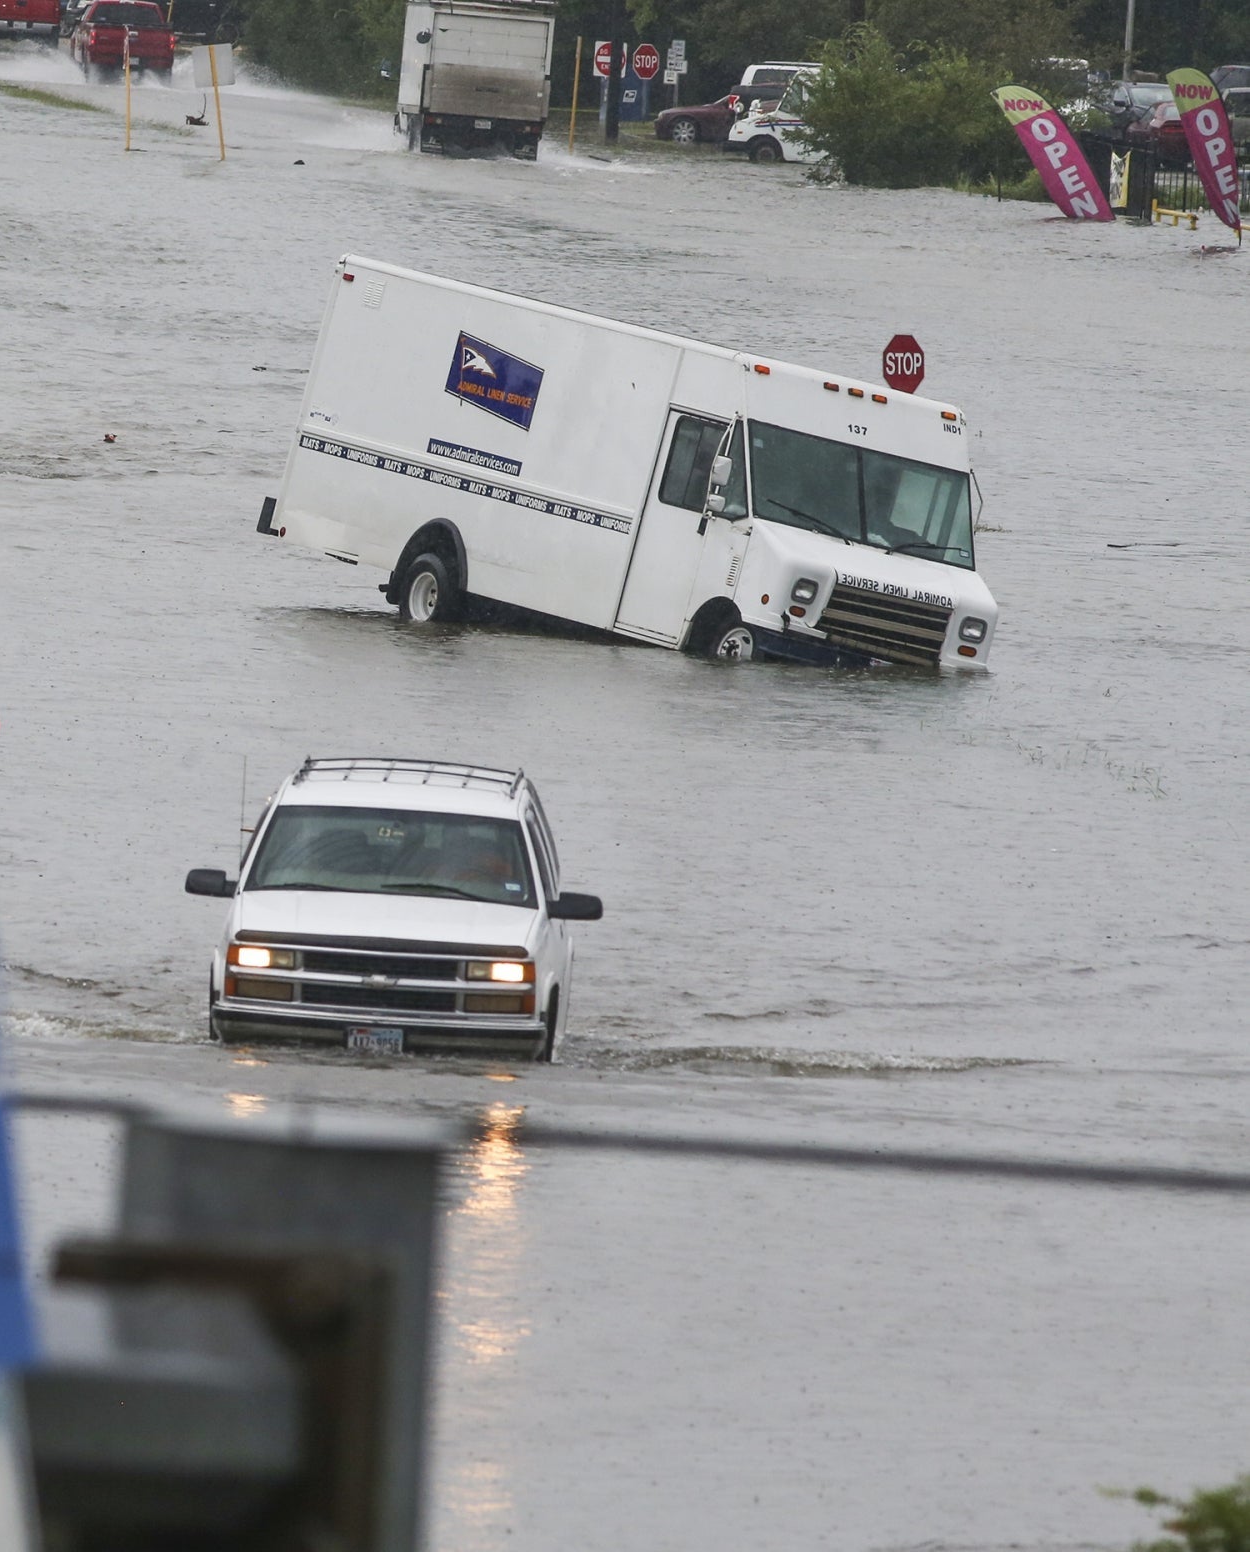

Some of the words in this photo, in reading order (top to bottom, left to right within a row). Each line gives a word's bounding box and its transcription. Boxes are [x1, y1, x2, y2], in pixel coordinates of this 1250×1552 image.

[635, 55, 658, 68] STOP
[1175, 84, 1213, 100] NOW
[1004, 99, 1043, 111] NOW
[1031, 118, 1099, 217] OPEN
[885, 352, 922, 375] STOP
[458, 381, 485, 396] ADMIRAL
[487, 388, 506, 402] LINEN
[507, 392, 532, 409] SERVICE
[848, 424, 868, 435] 137
[431, 442, 519, 475] www.admiralservices.com
[302, 436, 320, 450] MATS
[324, 442, 343, 456] MOPS
[347, 449, 379, 466] UNIFORMS
[384, 459, 402, 472] MATS
[406, 465, 425, 479] MOPS
[430, 471, 462, 488] UNIFORMS
[469, 481, 488, 495] MATS
[491, 487, 510, 501] MOPS
[515, 494, 548, 512] UNIFORMS
[553, 504, 572, 518] MATS
[576, 510, 595, 524] MOPS
